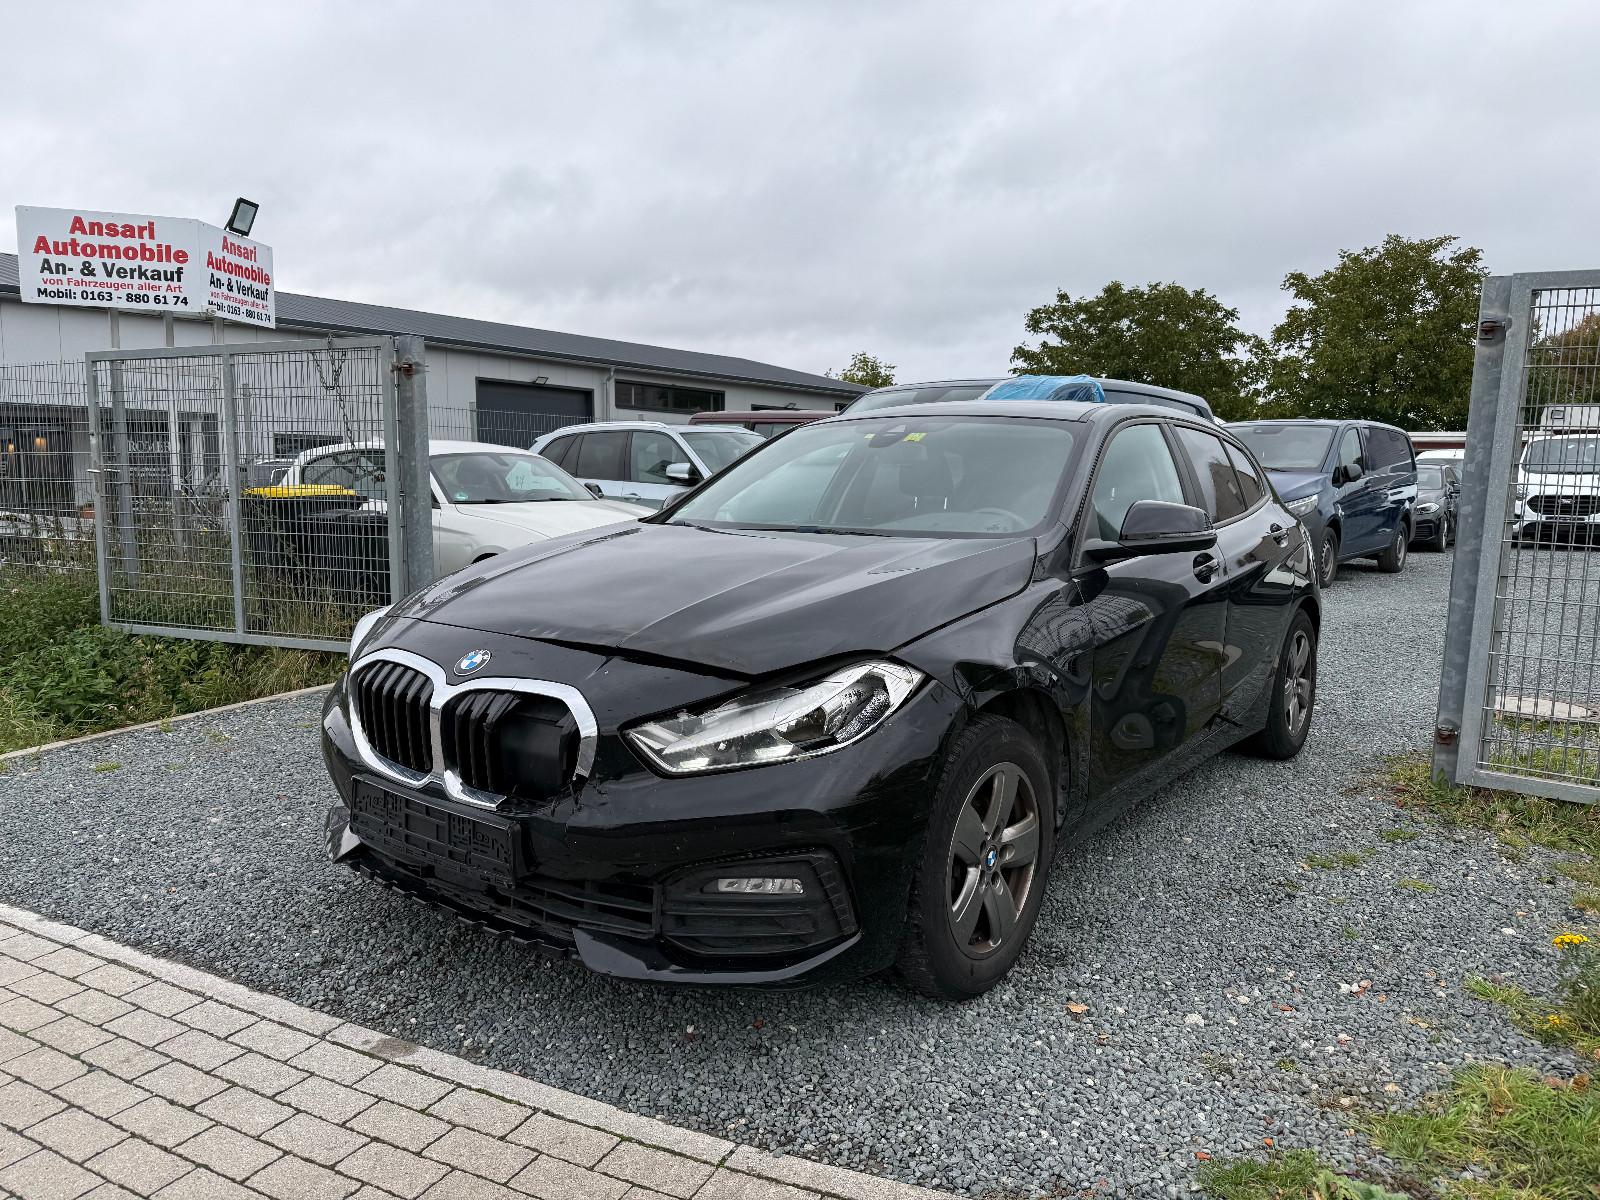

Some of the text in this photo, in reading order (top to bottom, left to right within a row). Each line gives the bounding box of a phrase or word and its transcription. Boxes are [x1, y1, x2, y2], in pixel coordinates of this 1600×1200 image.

[69, 216, 155, 240] Ansari
[33, 235, 189, 264] Automobile
[222, 235, 257, 262] Ansari
[40, 258, 184, 282] An- & Verkauf
[207, 251, 270, 286] Automobile
[37, 287, 77, 300] Mobil:
[80, 290, 113, 302] 0163
[125, 293, 150, 304] 880
[153, 294, 169, 305] 61
[173, 295, 189, 306] 74
[42, 278, 183, 293] von Fahrzeugen aller Art
[209, 272, 269, 302] An- & Verkauf
[226, 304, 241, 316] 0163
